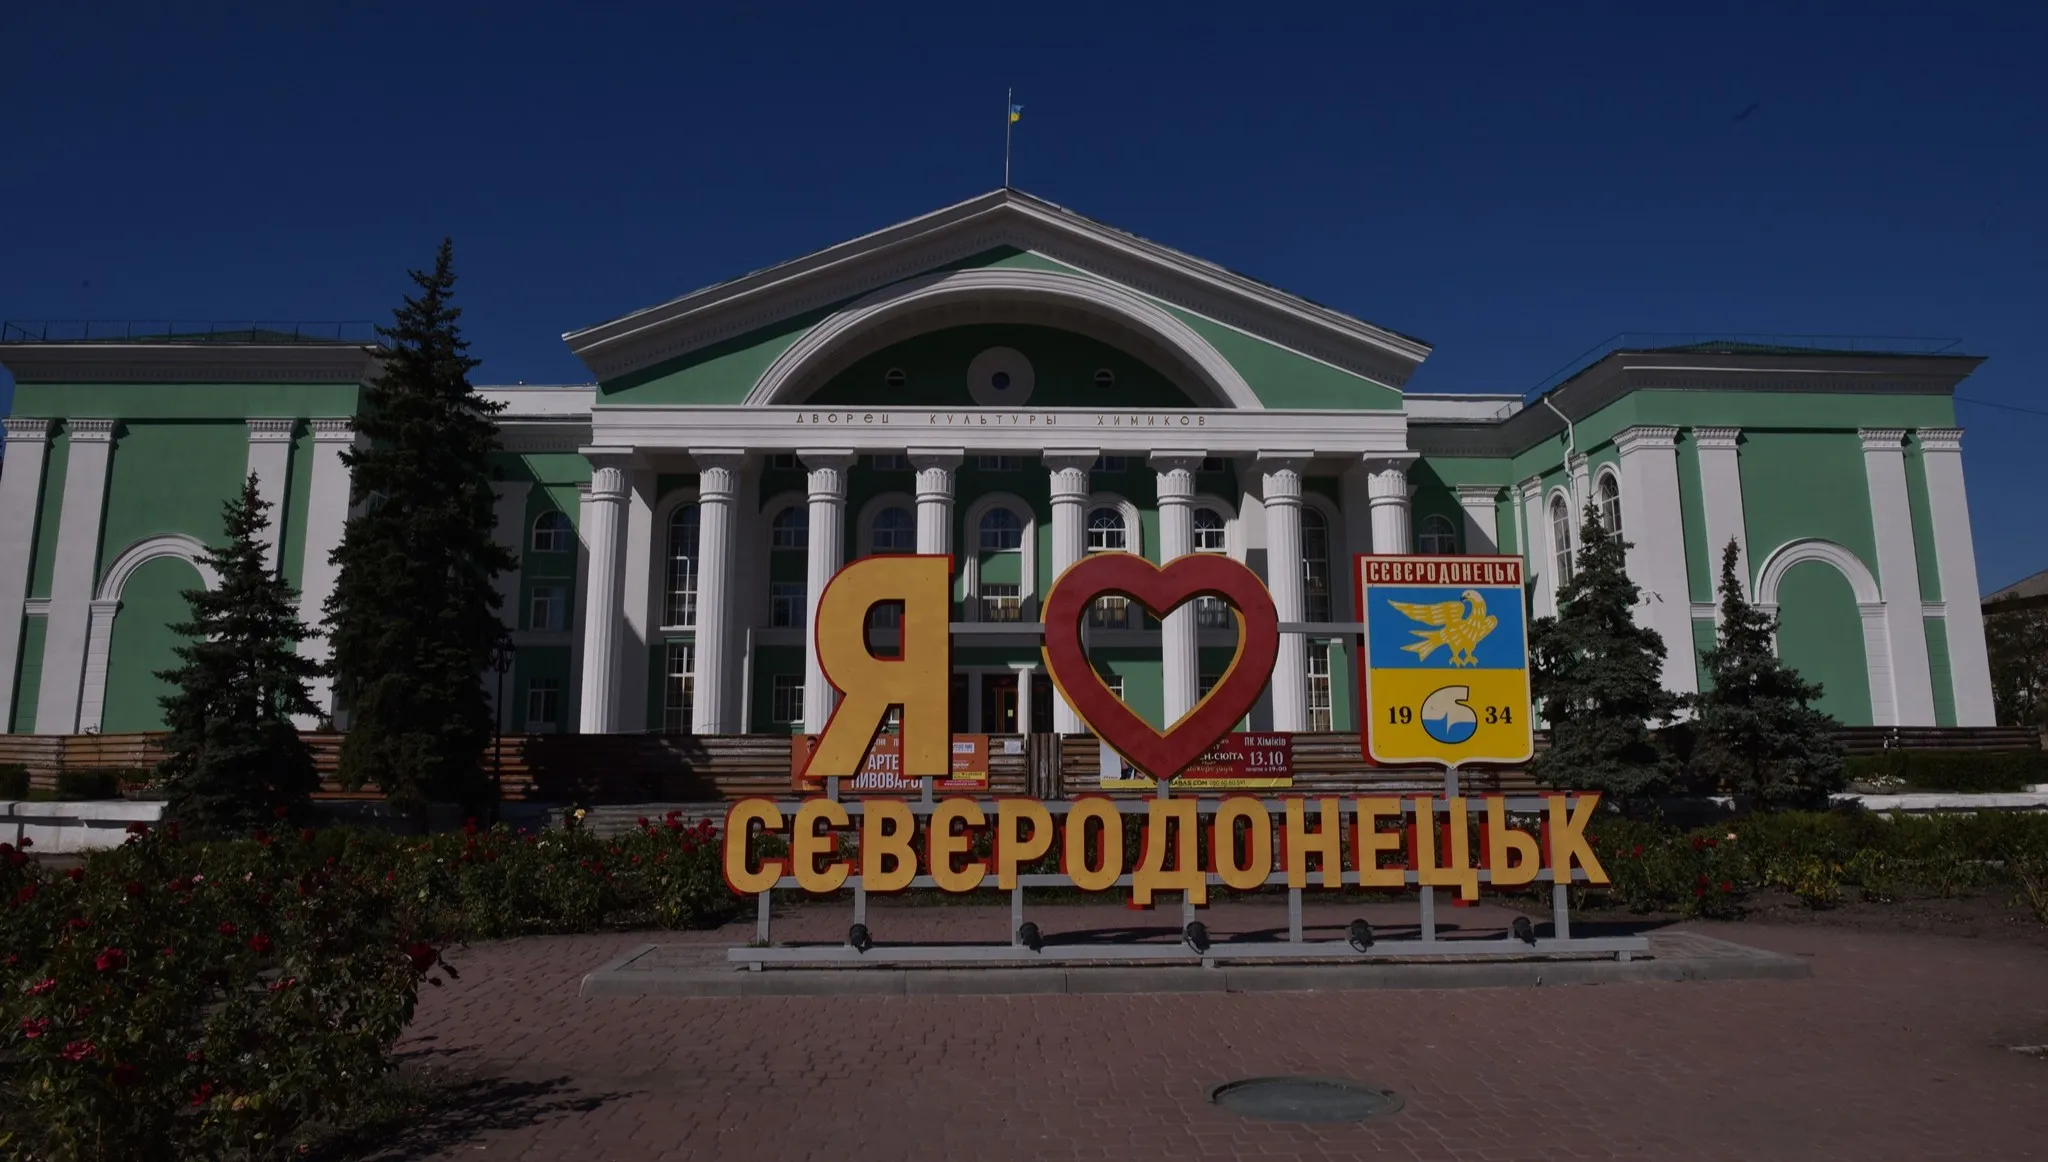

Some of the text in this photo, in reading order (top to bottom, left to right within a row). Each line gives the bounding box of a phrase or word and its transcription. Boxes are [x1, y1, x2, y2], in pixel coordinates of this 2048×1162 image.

[930, 414, 1057, 425] КУЛЬТУРЫ
[1097, 415, 1206, 426] ХИМИКОВ
[1369, 561, 1517, 584] СЄВЄРОДОНЕЦЬК
[804, 554, 954, 778] Я
[1388, 705, 1513, 725] 19 34
[867, 753, 899, 770] АРТЕ
[1249, 750, 1284, 766] 13.10
[726, 794, 1611, 907] СЄВЄРОДОНЕЦЬК
